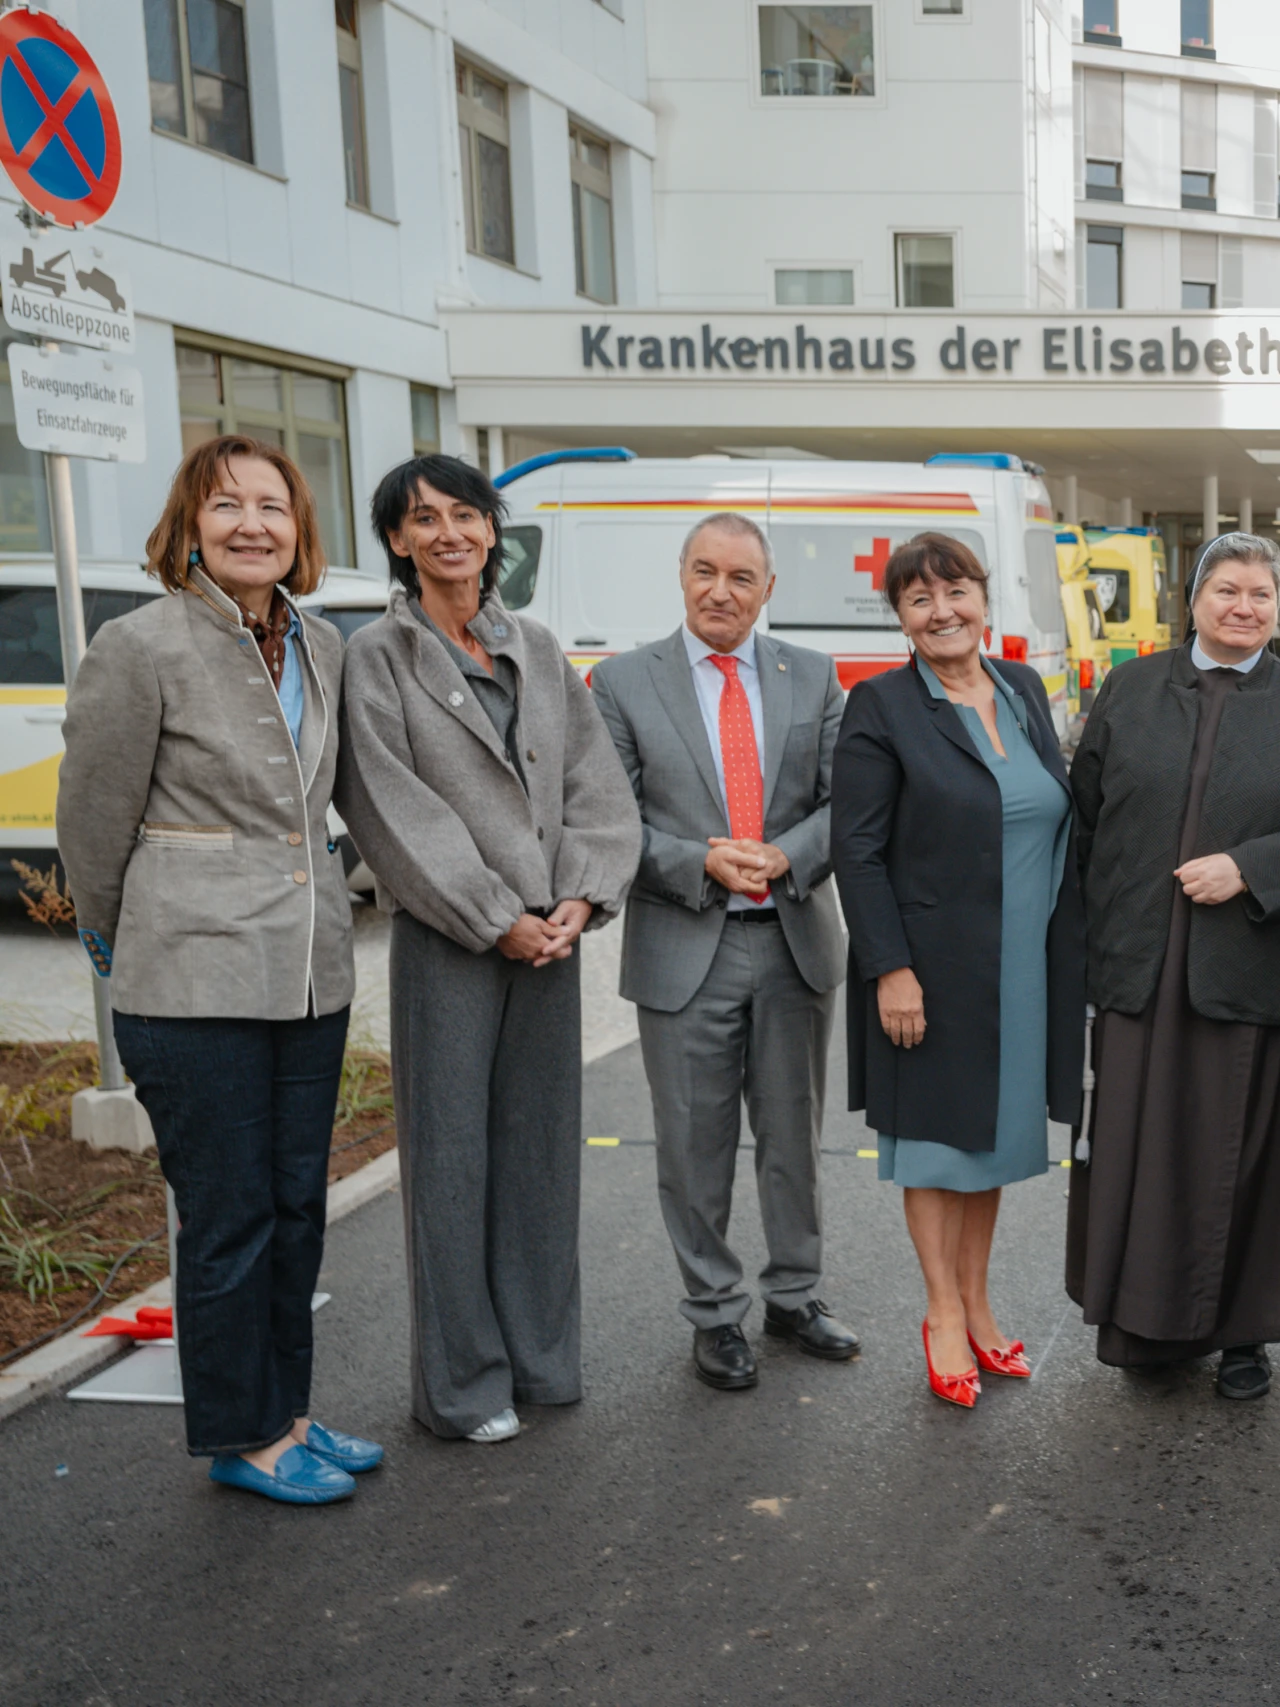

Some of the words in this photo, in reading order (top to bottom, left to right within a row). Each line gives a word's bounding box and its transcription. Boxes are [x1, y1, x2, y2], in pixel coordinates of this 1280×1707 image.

[11, 294, 130, 342] Abschleppzone
[581, 323, 917, 371] Krankenhaus
[939, 325, 1021, 372] der
[21, 369, 117, 404] Bewegungsfläche
[120, 387, 134, 407] für
[37, 408, 127, 442] Einsatzfahrzeuge
